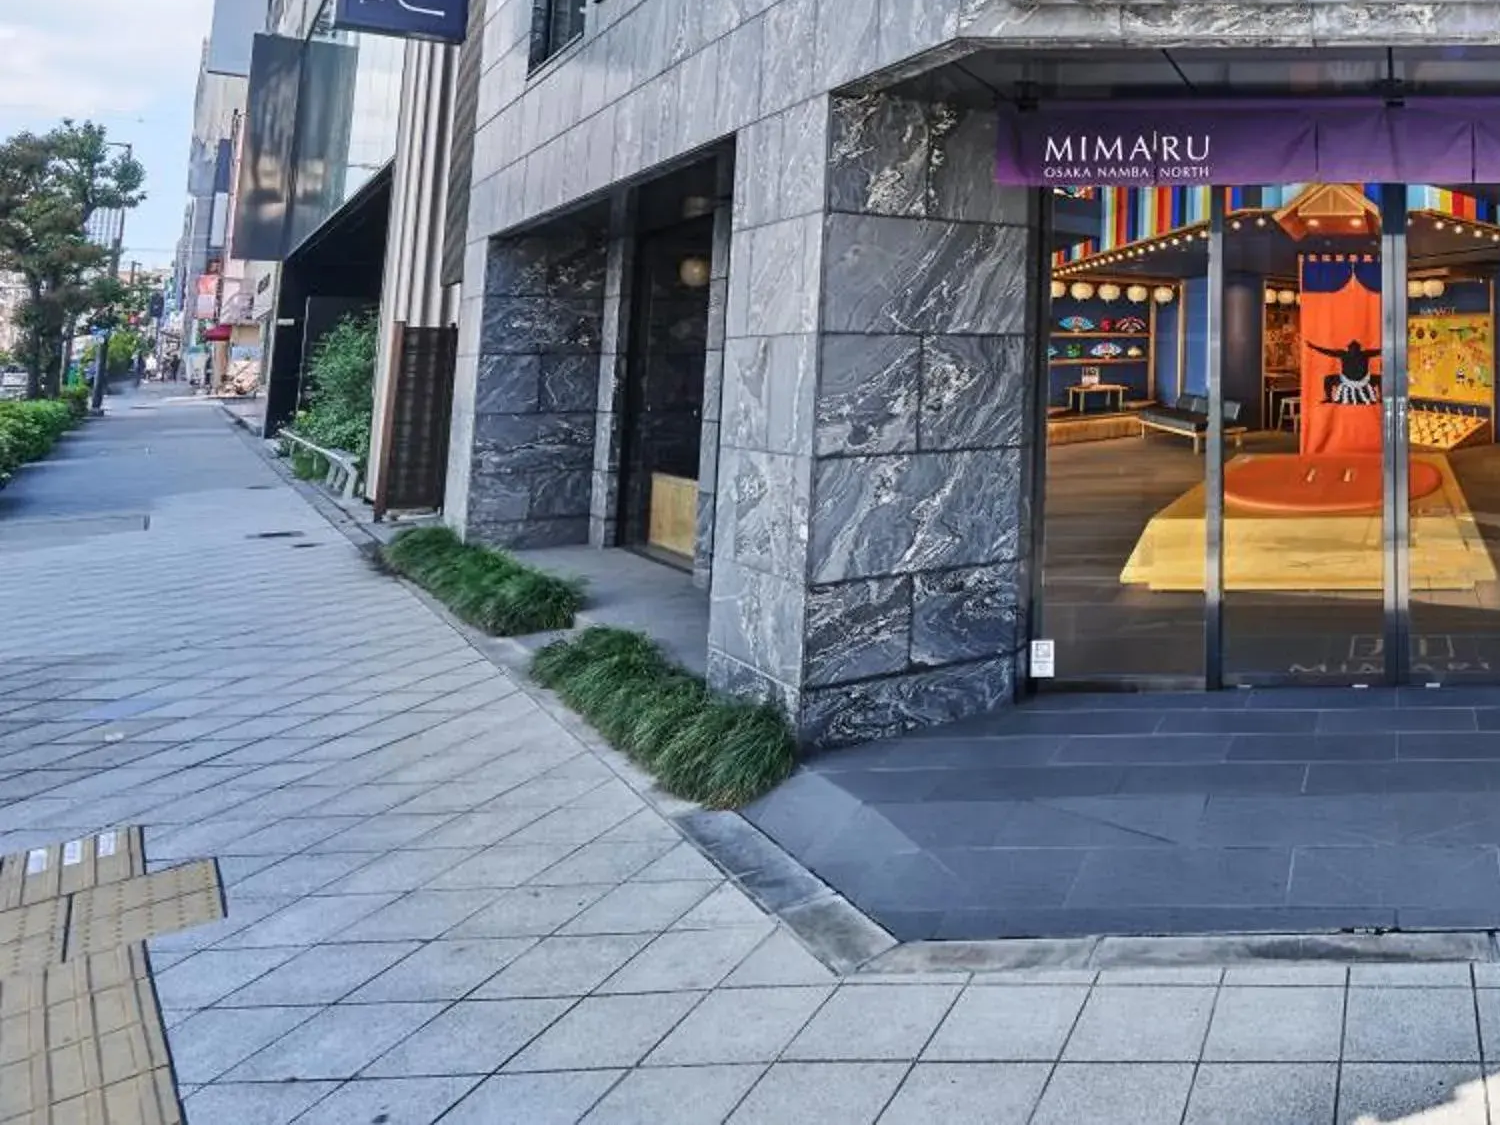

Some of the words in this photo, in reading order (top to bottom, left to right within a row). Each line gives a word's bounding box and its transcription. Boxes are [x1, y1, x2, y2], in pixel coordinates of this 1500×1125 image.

[1044, 135, 1210, 162] MIMARU
[1044, 166, 1091, 178] OSAKA
[1097, 166, 1150, 177] NAMBA
[1159, 166, 1209, 177] NORTH
